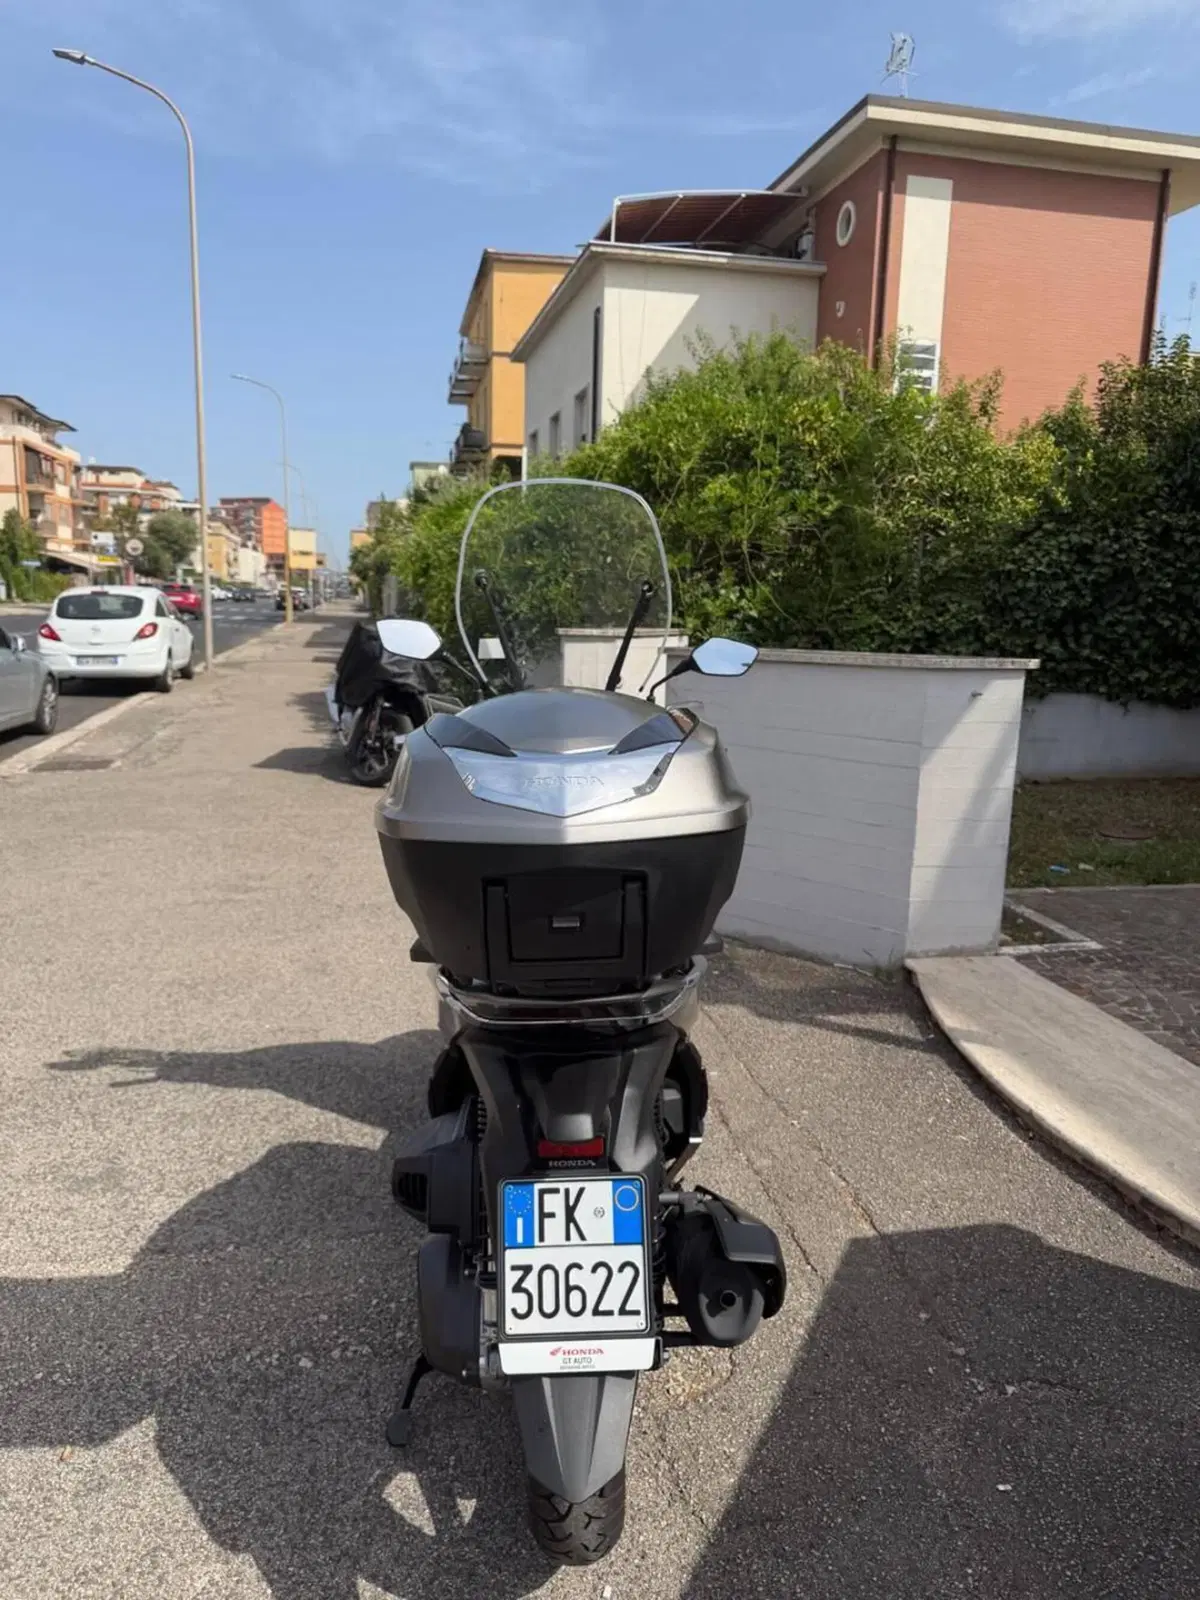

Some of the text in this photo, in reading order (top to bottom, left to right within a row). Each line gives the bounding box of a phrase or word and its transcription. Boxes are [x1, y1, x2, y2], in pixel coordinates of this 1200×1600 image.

[523, 775, 604, 788] HONDA
[548, 1159, 597, 1168] HONDA
[537, 1187, 587, 1242] FK
[510, 1260, 641, 1320] 30622
[562, 1347, 605, 1356] HONDA
[573, 1356, 593, 1364] AUTO
